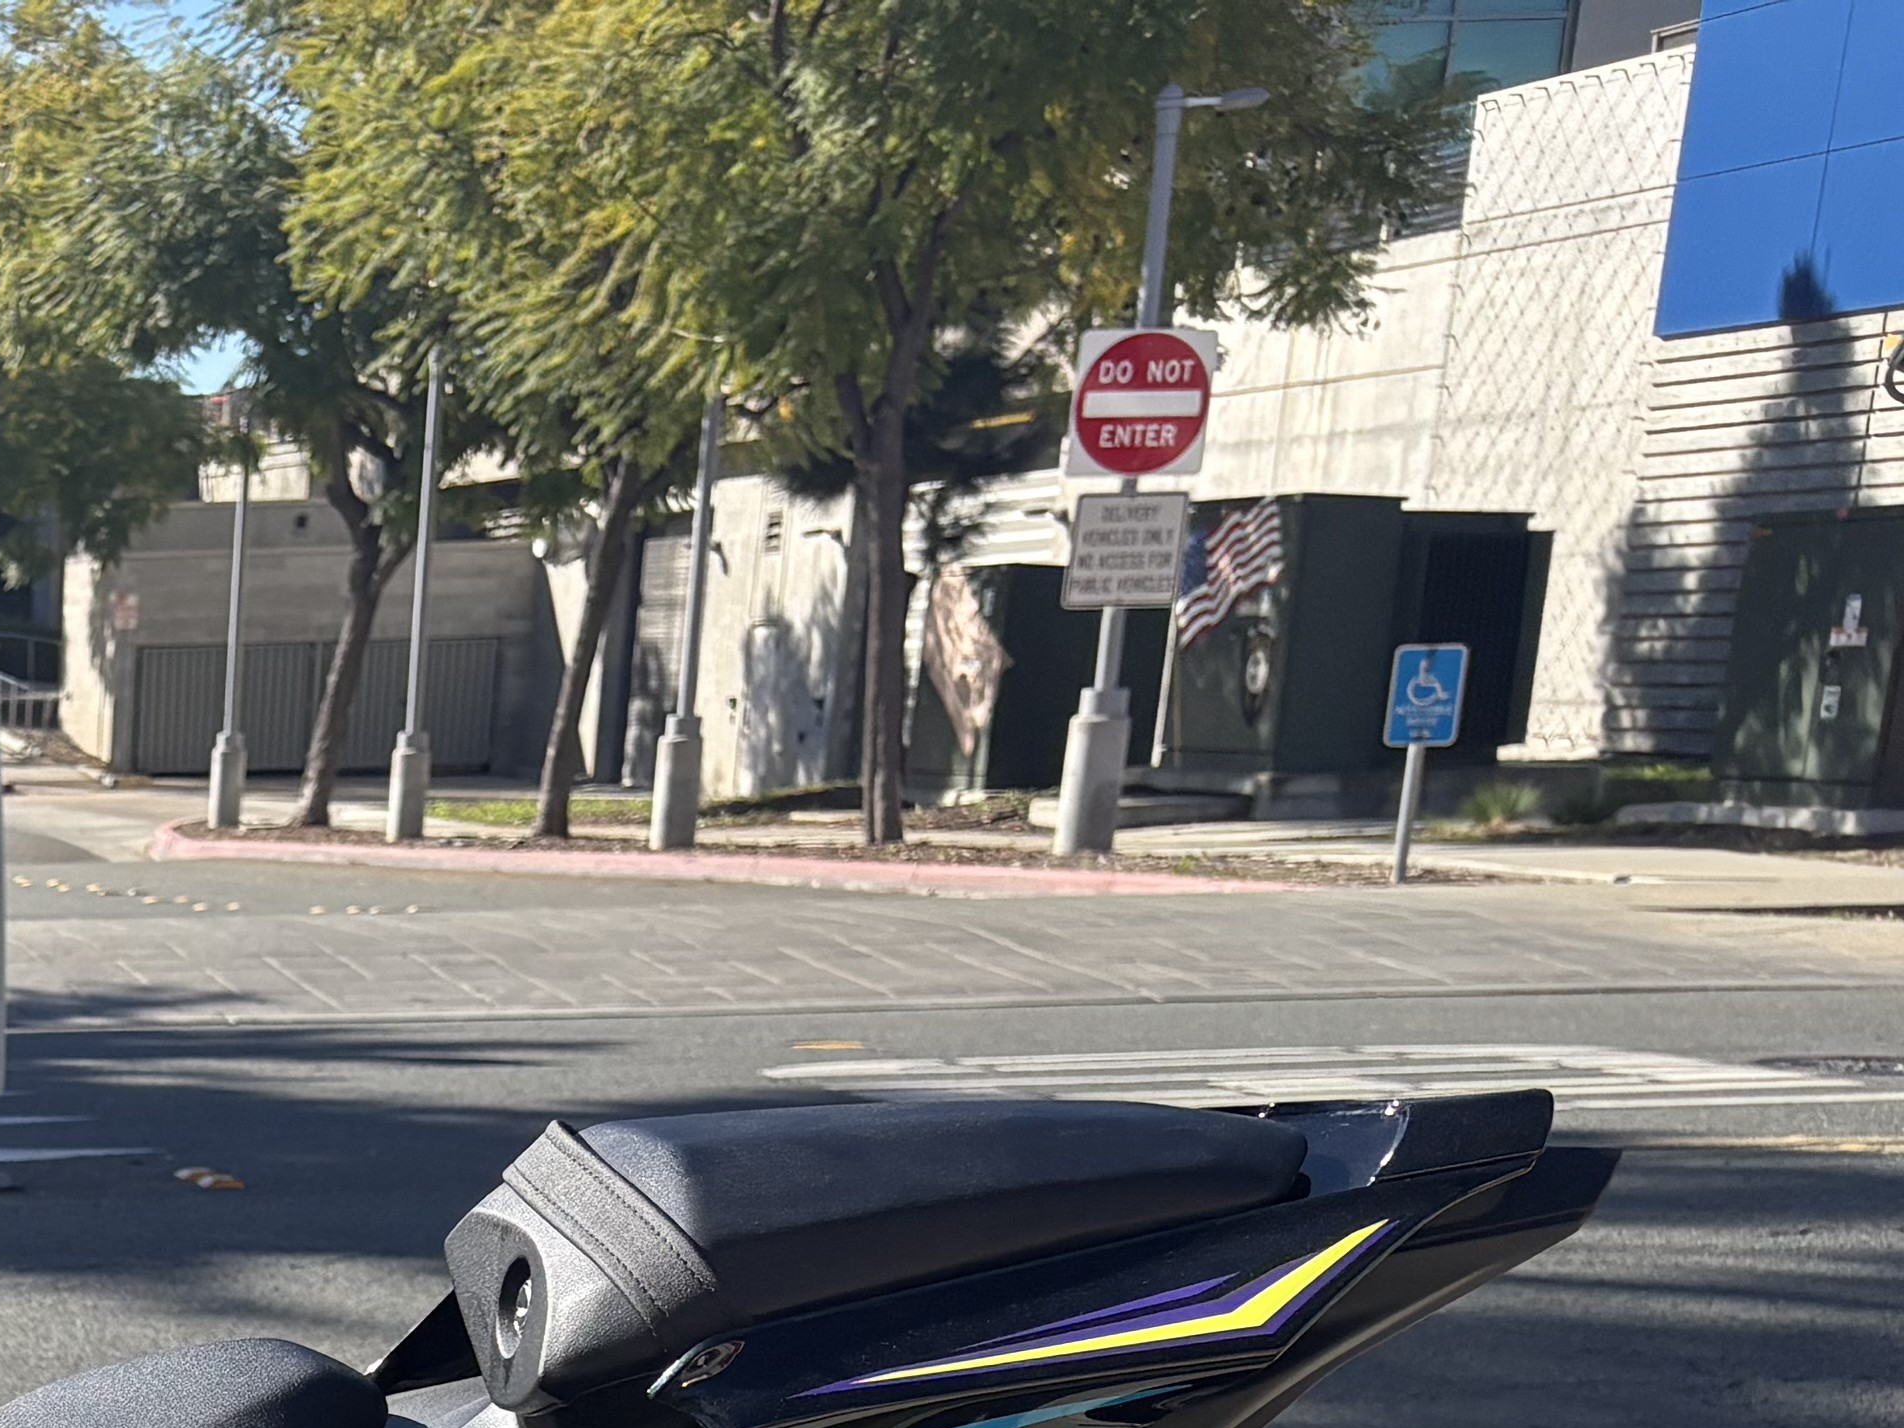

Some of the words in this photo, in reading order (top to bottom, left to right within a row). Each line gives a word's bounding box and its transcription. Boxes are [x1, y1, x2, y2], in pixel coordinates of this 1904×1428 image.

[1098, 359, 1134, 385] DO
[1146, 358, 1195, 384] NOT
[1098, 422, 1178, 449] ENTER
